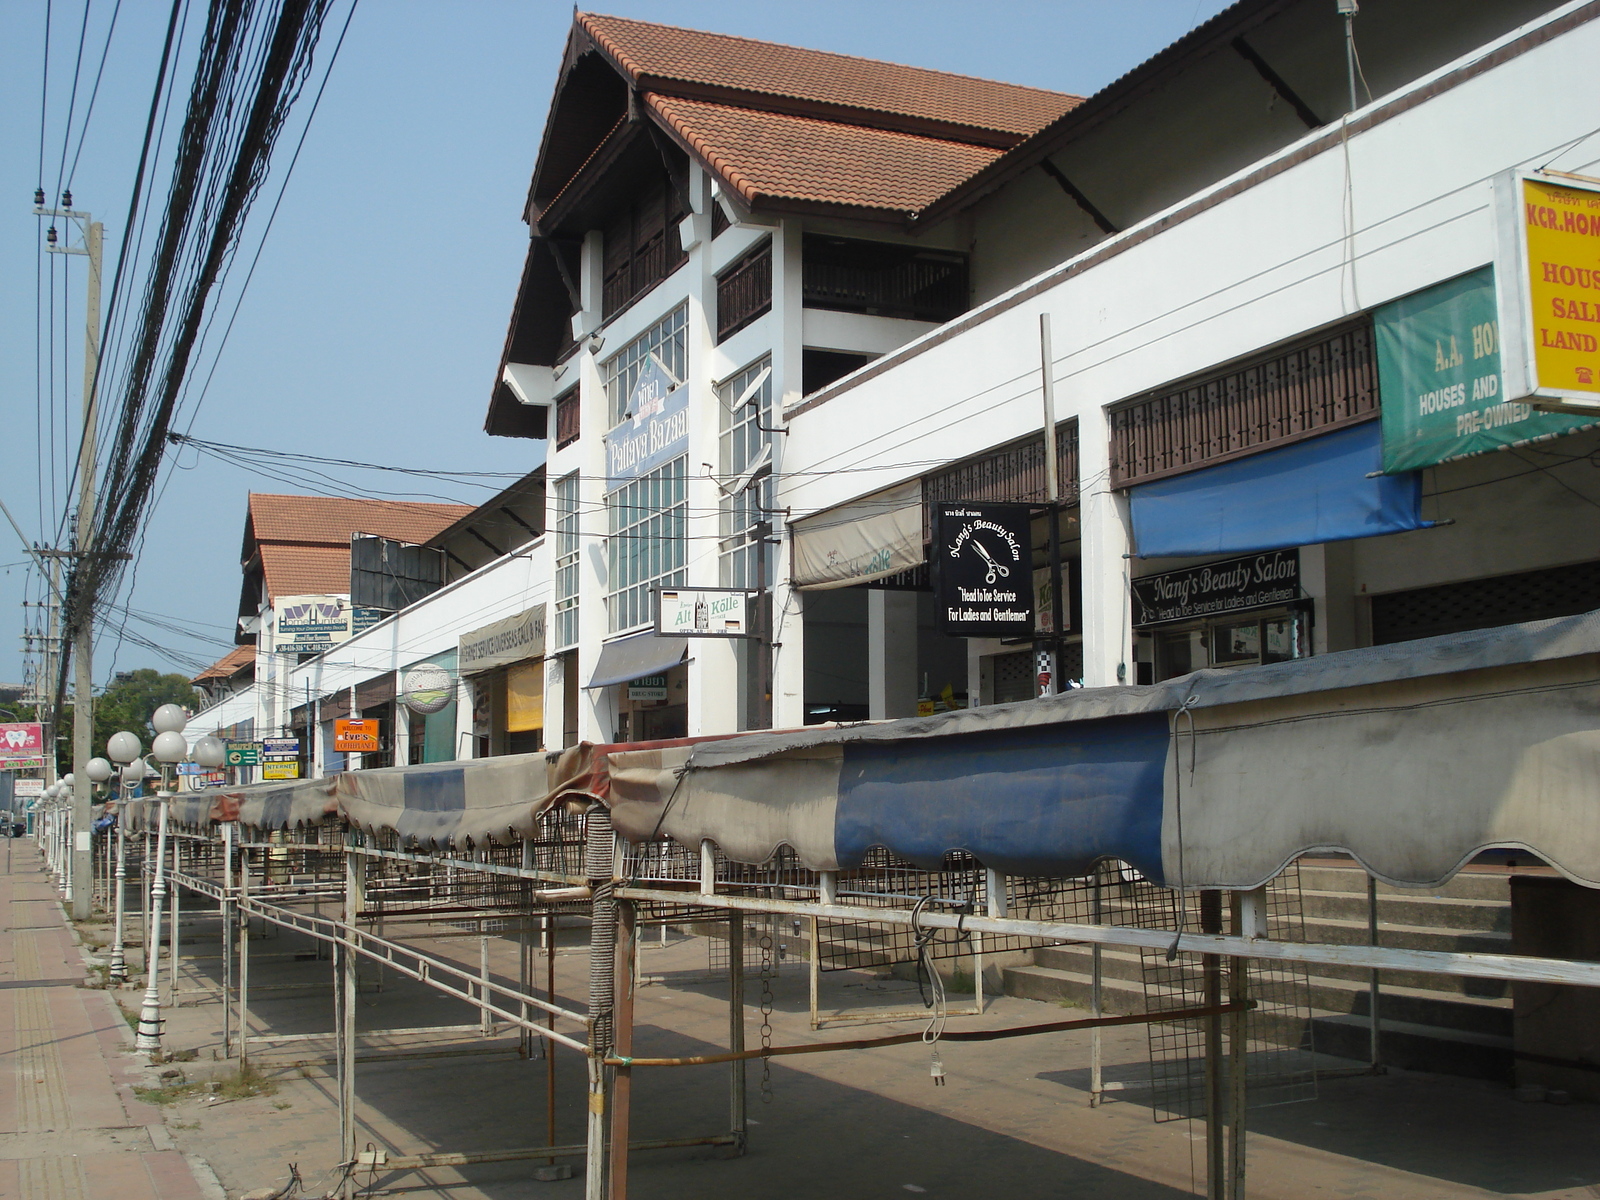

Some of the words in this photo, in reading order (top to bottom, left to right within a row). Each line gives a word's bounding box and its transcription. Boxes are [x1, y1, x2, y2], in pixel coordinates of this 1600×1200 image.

[1541, 328, 1598, 353] LAND
[1435, 334, 1464, 373] A.A.
[1419, 382, 1466, 416] HOUSES
[1471, 374, 1498, 401] AND
[1456, 403, 1531, 437] PRE-OWNED
[610, 432, 648, 476] Pattaya
[649, 407, 689, 455] Bazaar
[948, 523, 973, 558] Nang's
[973, 519, 1007, 538] Beauty
[1005, 532, 1021, 561] Salon
[1154, 573, 1198, 606] Nang's
[1200, 563, 1251, 592] Beauty
[1253, 552, 1296, 583] Salon
[710, 596, 739, 615] Kölle
[977, 588, 983, 602] to
[983, 588, 993, 602] Toe
[993, 589, 1017, 602] Service
[1193, 600, 1216, 614] Service
[1224, 593, 1245, 609] Ladies
[1246, 591, 1257, 605] and
[675, 610, 692, 626] Alt
[948, 607, 958, 621] For
[959, 607, 979, 621] Ladies
[980, 608, 992, 621] and
[344, 731, 369, 741] Eve's
[265, 763, 297, 771] INTERNET
